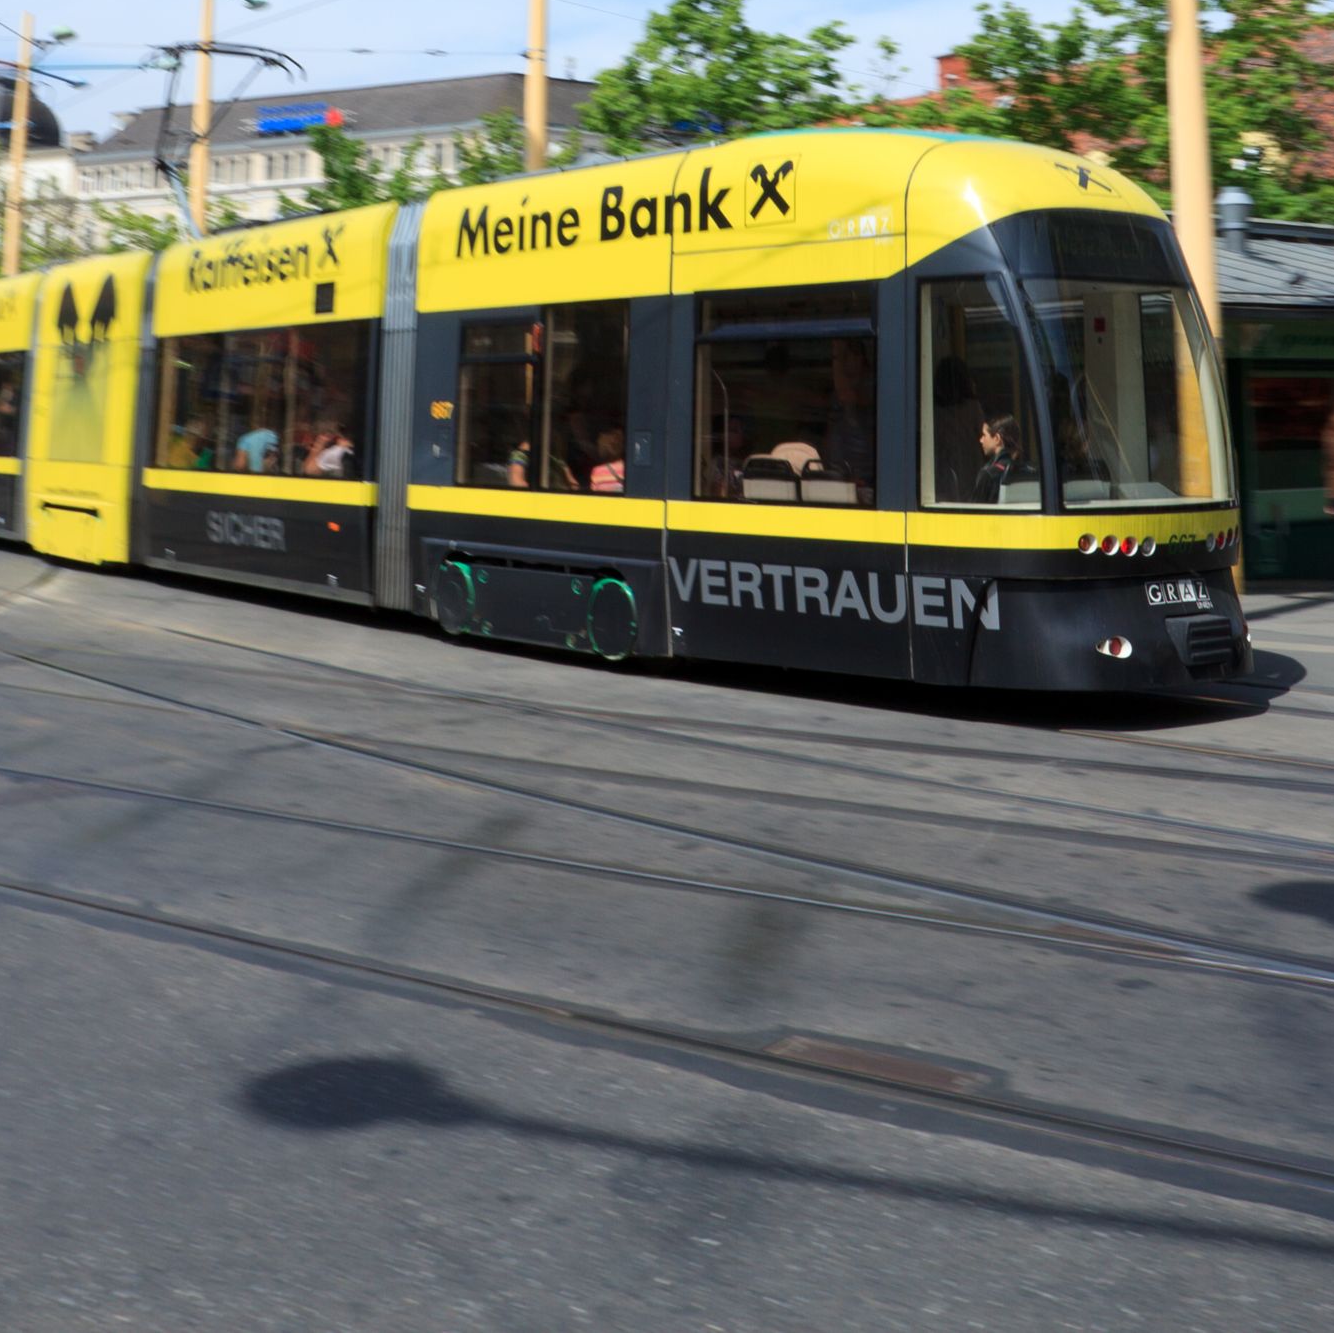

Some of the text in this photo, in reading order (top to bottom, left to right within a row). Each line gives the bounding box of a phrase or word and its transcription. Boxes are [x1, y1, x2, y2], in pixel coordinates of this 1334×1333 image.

[456, 167, 733, 258] Meine Bank
[205, 510, 287, 552] SICHER
[1168, 534, 1197, 556] 667
[668, 556, 1000, 631] VERTRAUEN
[1147, 579, 1209, 604] GRAZ
